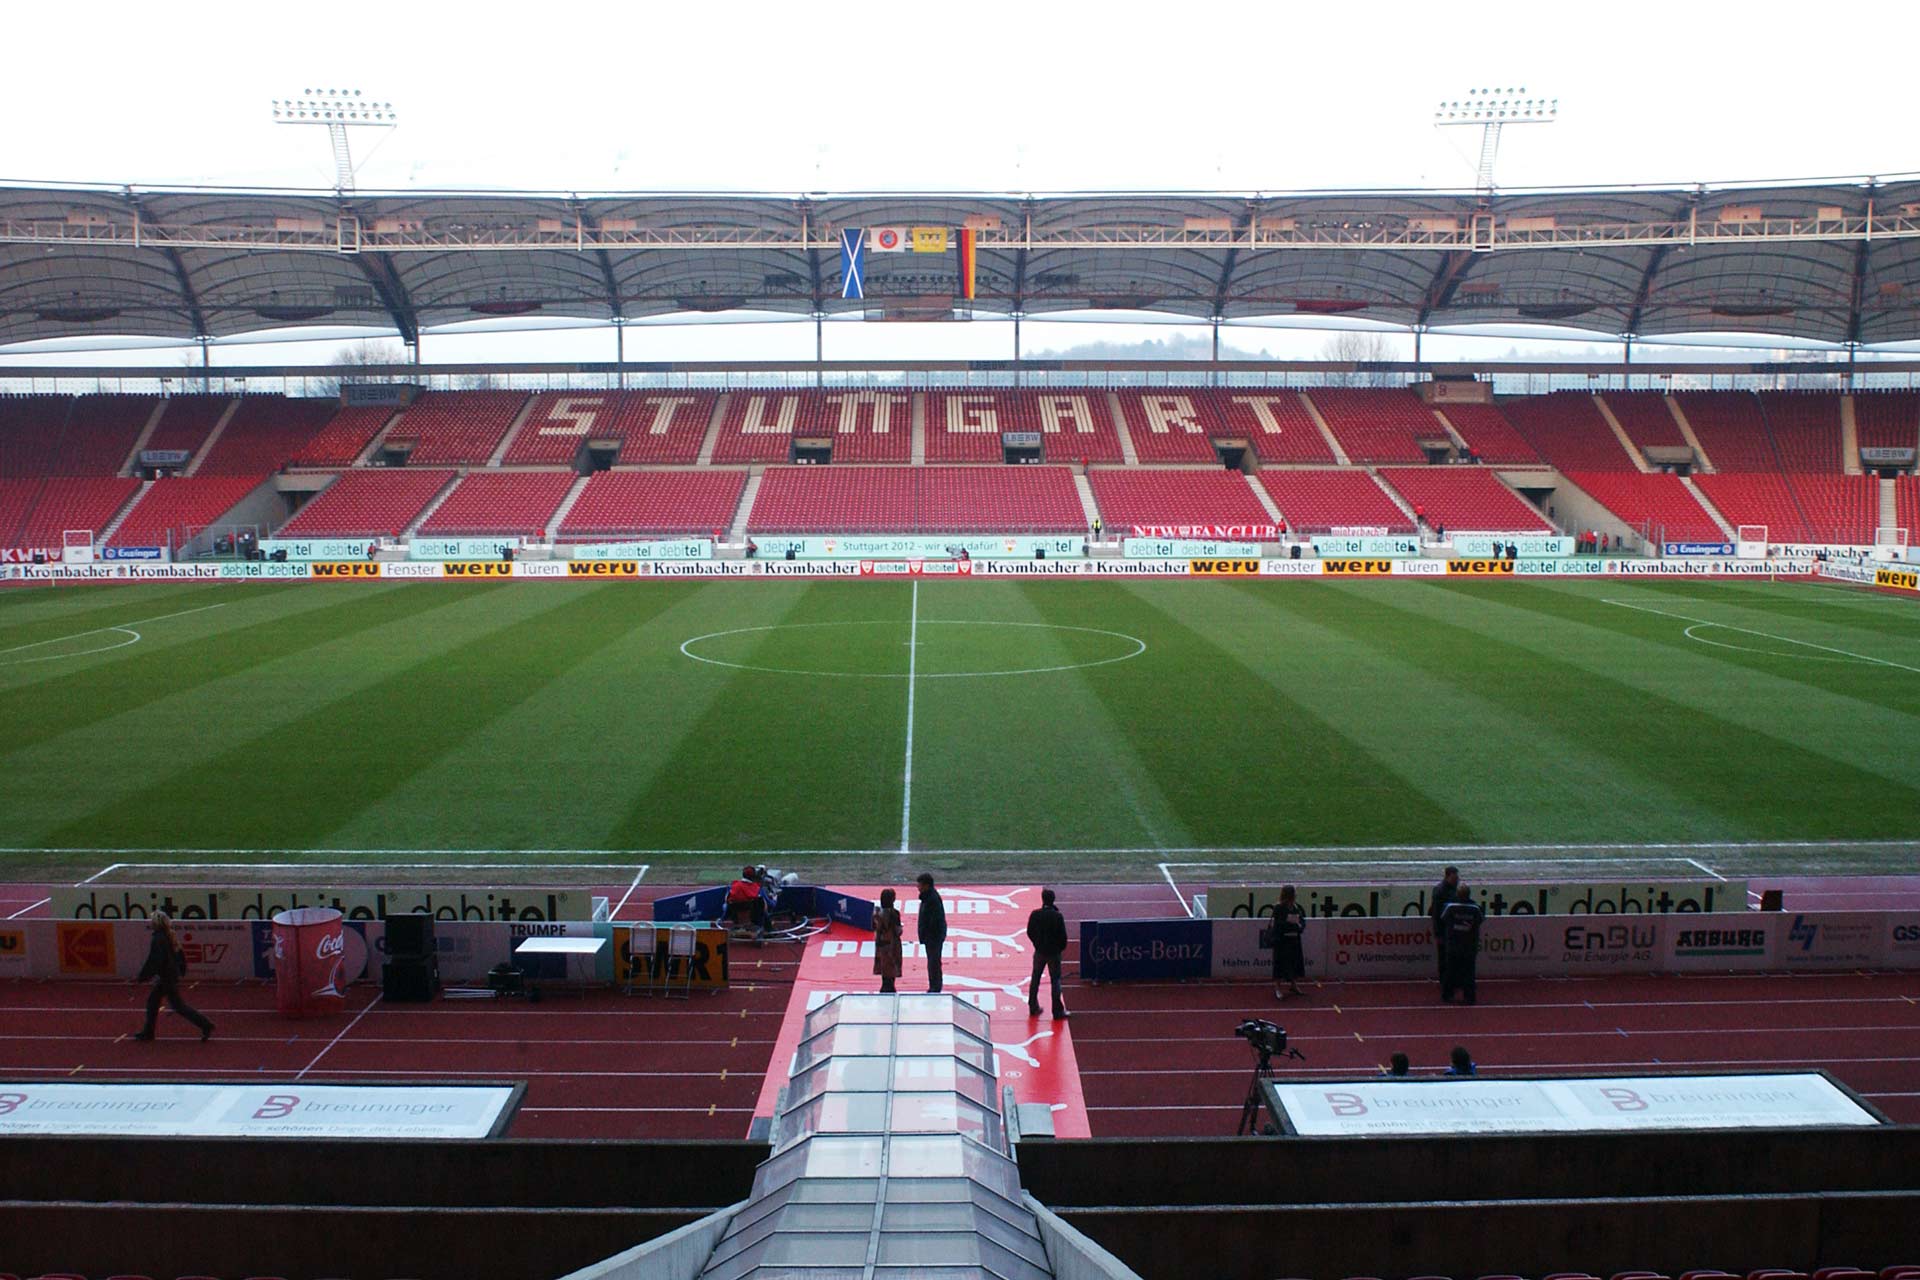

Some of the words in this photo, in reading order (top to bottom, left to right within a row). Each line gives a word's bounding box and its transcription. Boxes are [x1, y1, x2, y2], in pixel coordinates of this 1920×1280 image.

[323, 543, 363, 555] debitel
[420, 542, 460, 554] debitel
[616, 546, 651, 557] debitel
[660, 544, 701, 556] debitel
[843, 542, 888, 552] Stuttgart
[891, 542, 915, 551] 2012
[925, 542, 940, 550] wir
[1131, 543, 1172, 555] debitel
[1182, 544, 1217, 555] debitel
[1322, 540, 1362, 552] debitel
[1521, 541, 1560, 552] debitel
[24, 565, 113, 578] Krombacher
[130, 565, 218, 577] Krombacher
[223, 565, 262, 576] debitel
[268, 565, 308, 576] debitel
[312, 563, 378, 575] weru
[387, 565, 435, 575] Fenster
[444, 562, 511, 574] weru
[569, 561, 636, 574] weru
[654, 562, 746, 574] Krombacher
[765, 562, 857, 574] Krombacher
[988, 561, 1080, 573] Krombacher
[1097, 561, 1189, 573] Krombacher
[1192, 560, 1259, 573] weru
[1267, 561, 1316, 573] Fenster
[1325, 560, 1391, 573] weru
[1449, 560, 1514, 573] weru
[1517, 561, 1556, 572] debitel
[1562, 561, 1602, 572] debitel
[1620, 561, 1708, 573] Krombacher
[1724, 561, 1811, 573] Krombacher
[1876, 571, 1918, 588] weru
[511, 924, 566, 936] TRUMPF
[1337, 929, 1432, 946] wüstenrot
[1565, 925, 1656, 950] EnBW
[1677, 930, 1765, 947] ARBURG
[1632, 950, 1652, 961] AG
[1223, 957, 1250, 967] Hahn
[29, 1099, 179, 1113] breuninger
[304, 1101, 457, 1115] breuninger
[1373, 1096, 1523, 1109] breuninger
